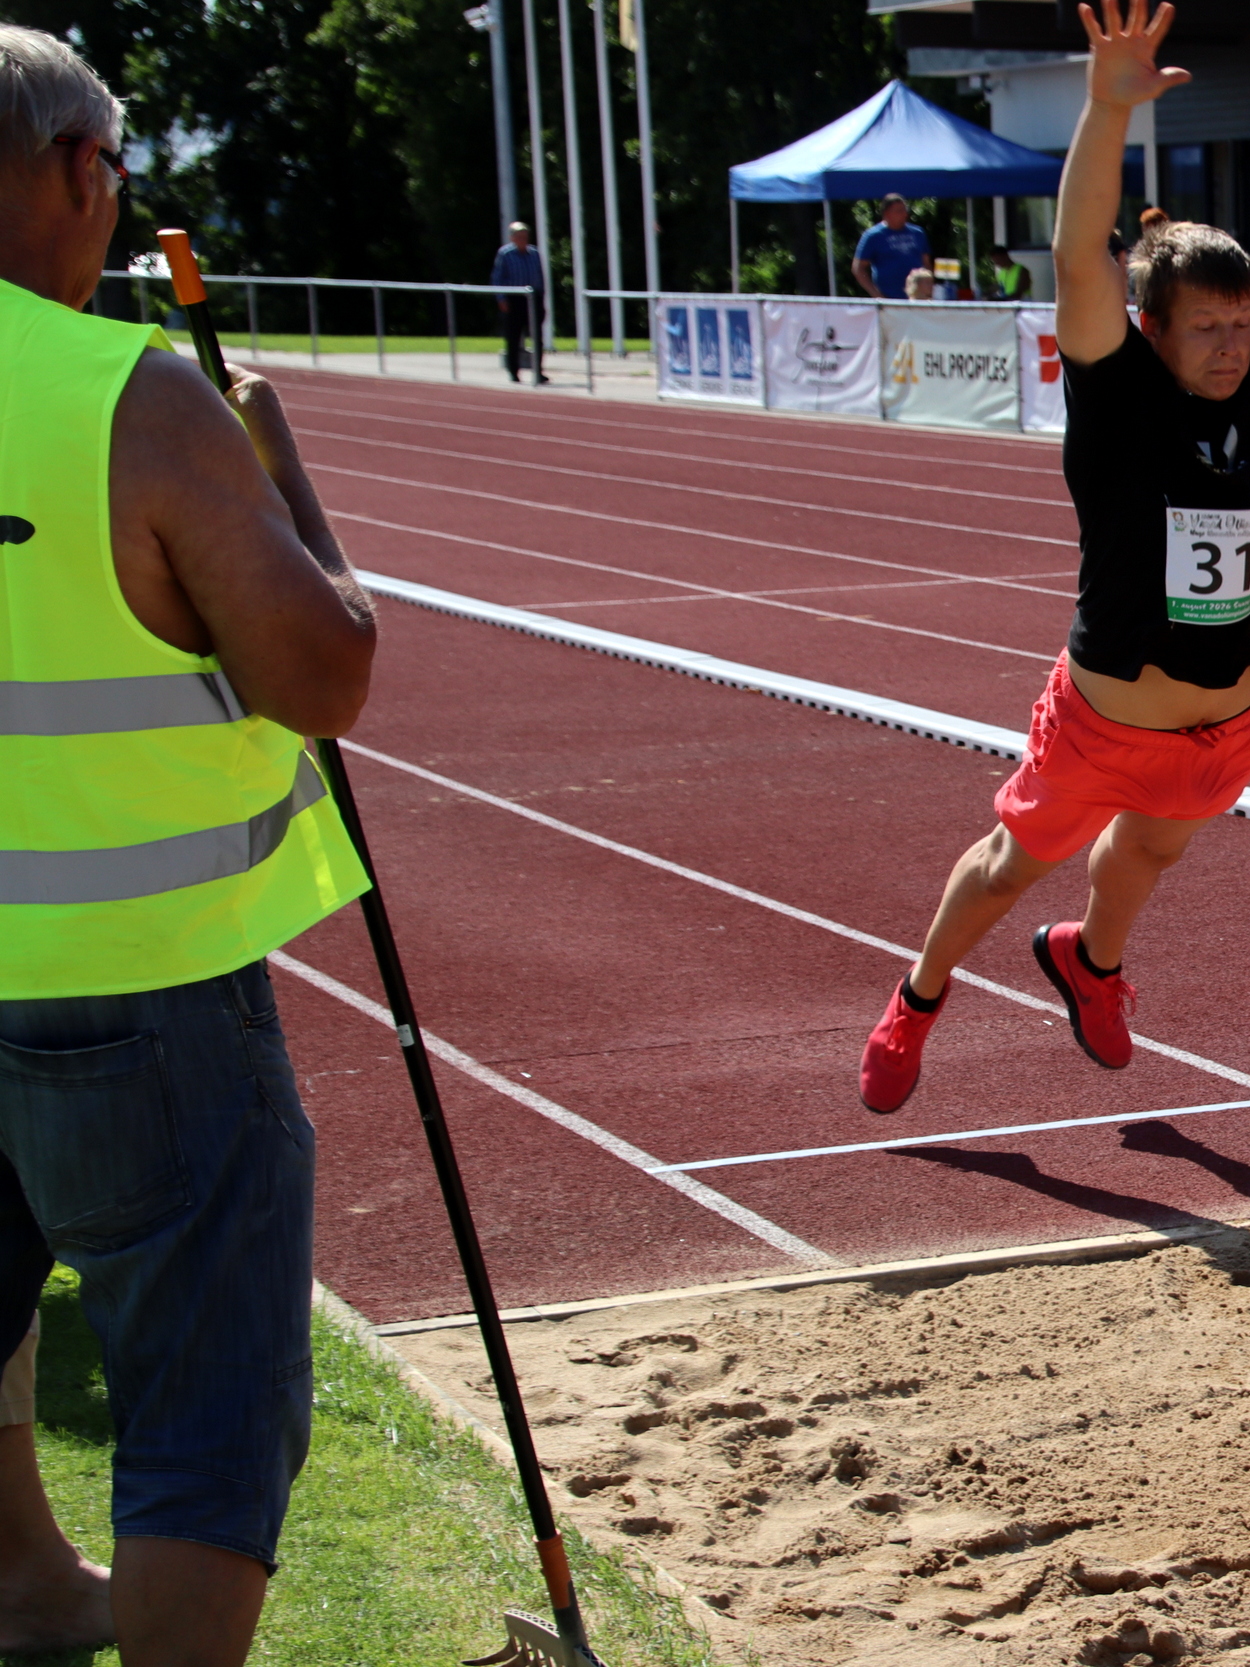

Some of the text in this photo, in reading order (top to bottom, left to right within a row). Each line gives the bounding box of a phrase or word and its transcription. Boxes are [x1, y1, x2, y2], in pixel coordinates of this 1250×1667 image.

[924, 352, 1008, 382] EHL PROFILES
[1172, 600, 1179, 608] 1.
[1181, 603, 1207, 612] august
